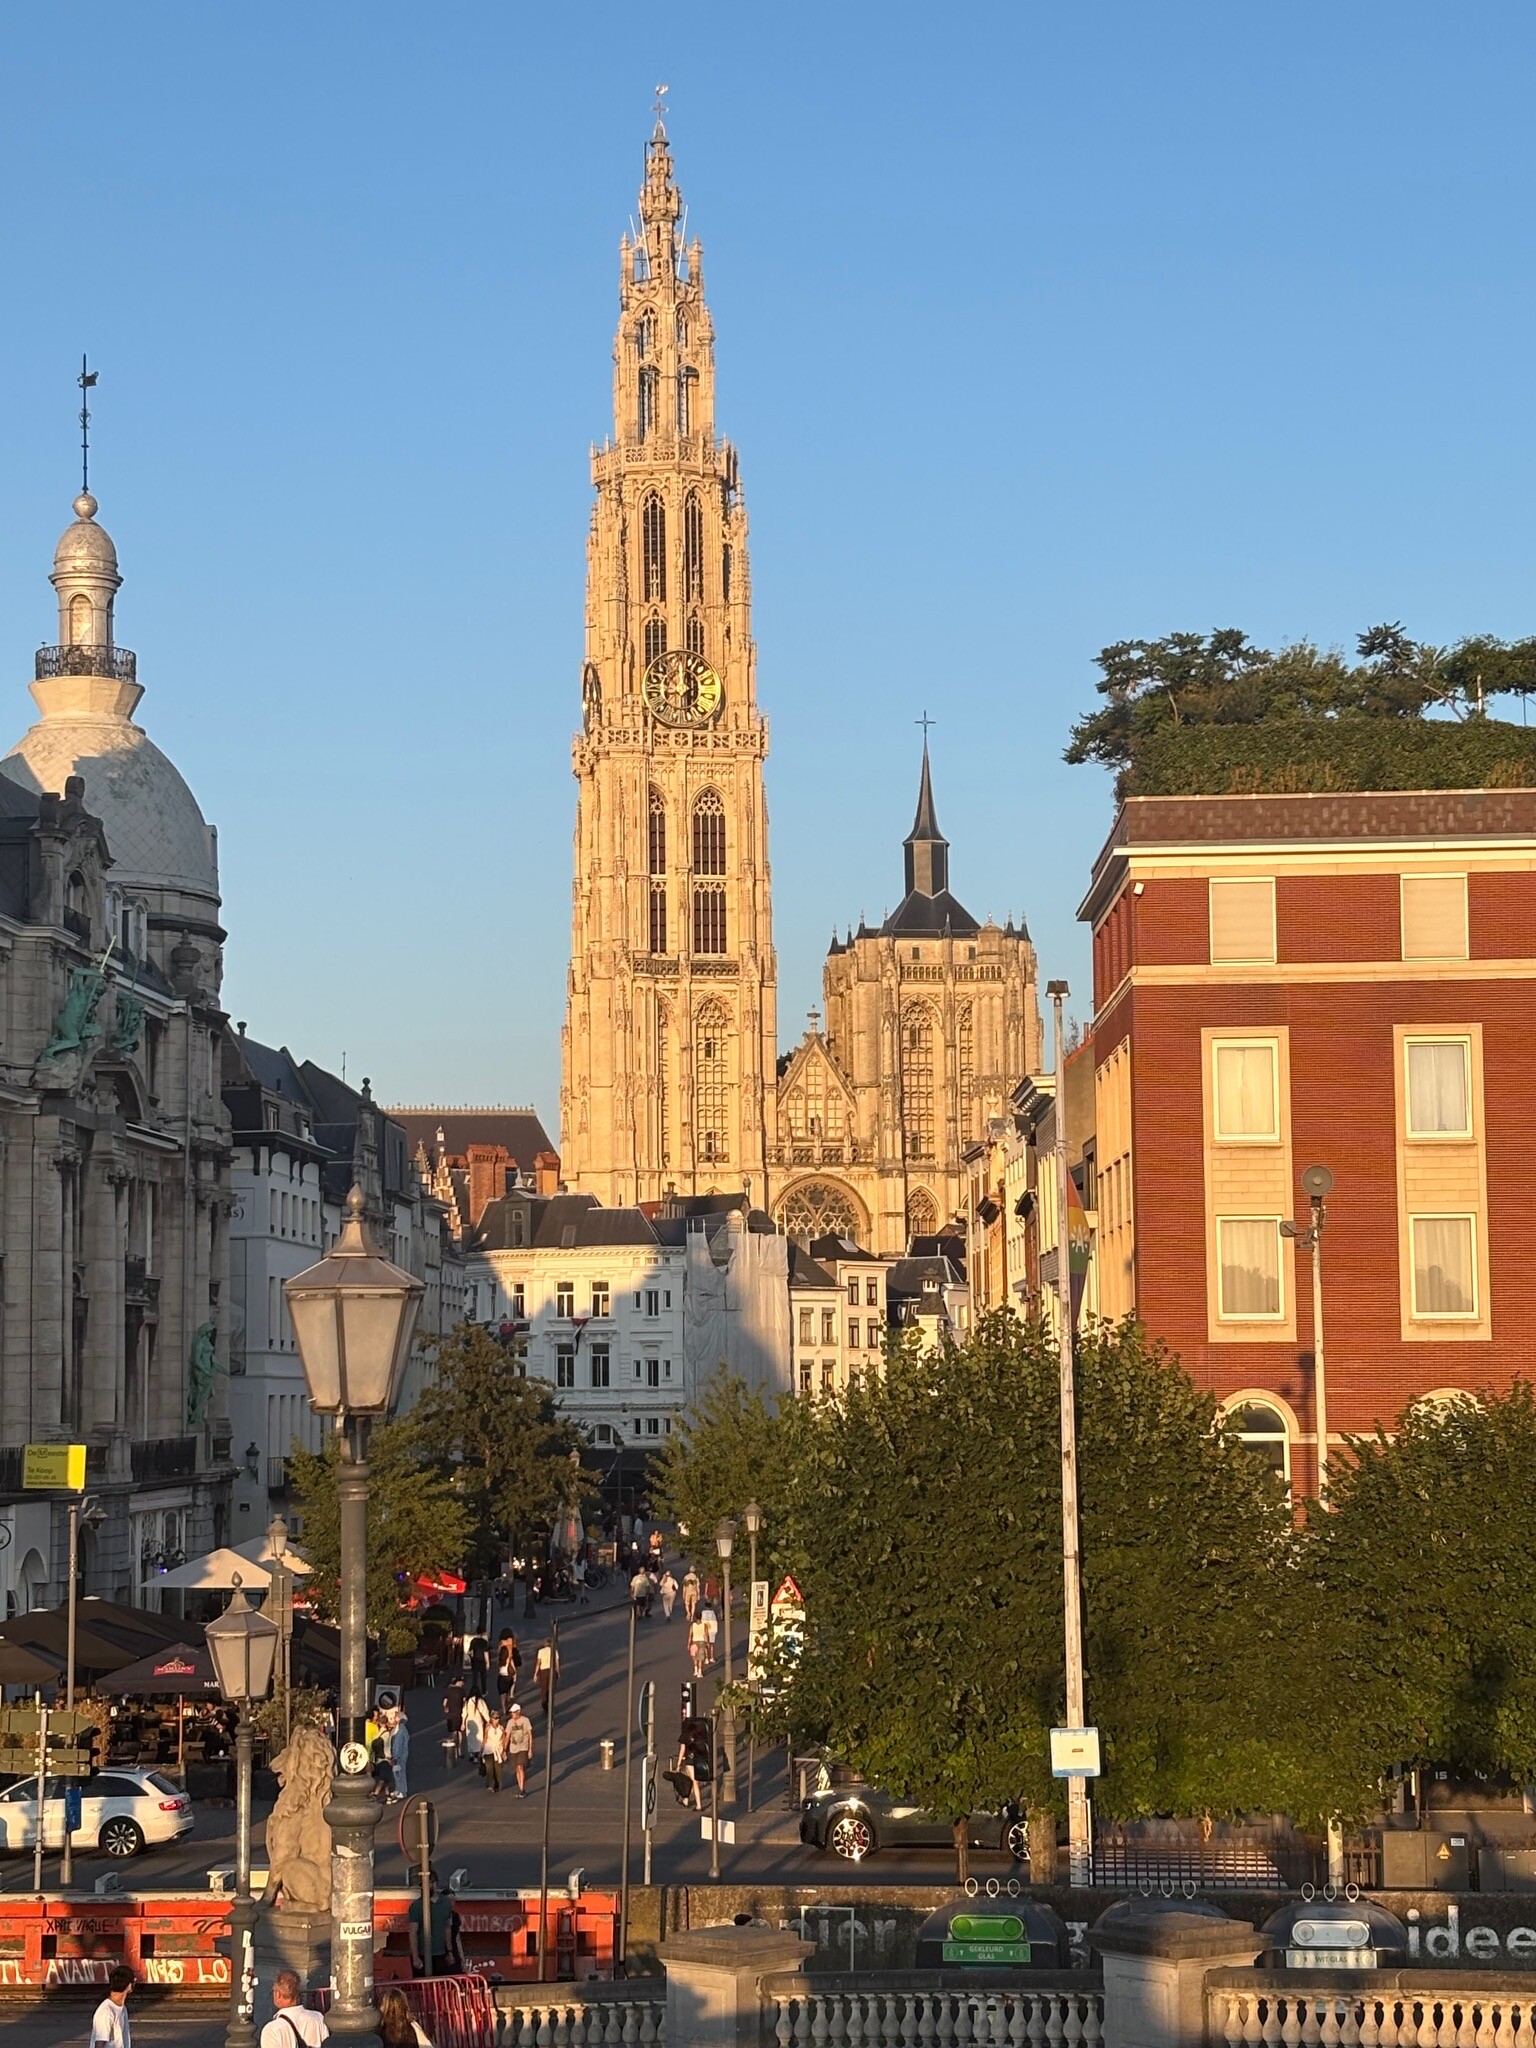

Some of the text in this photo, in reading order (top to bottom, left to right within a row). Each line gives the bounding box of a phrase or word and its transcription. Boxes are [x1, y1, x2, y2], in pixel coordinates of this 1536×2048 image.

[36, 1466, 54, 1475] Koop
[1406, 1905, 1536, 1959] idee
[969, 1945, 1004, 1953] GEKLEURD
[1315, 1955, 1348, 1963] WIT GLAS
[45, 1959, 120, 1984] AVANT
